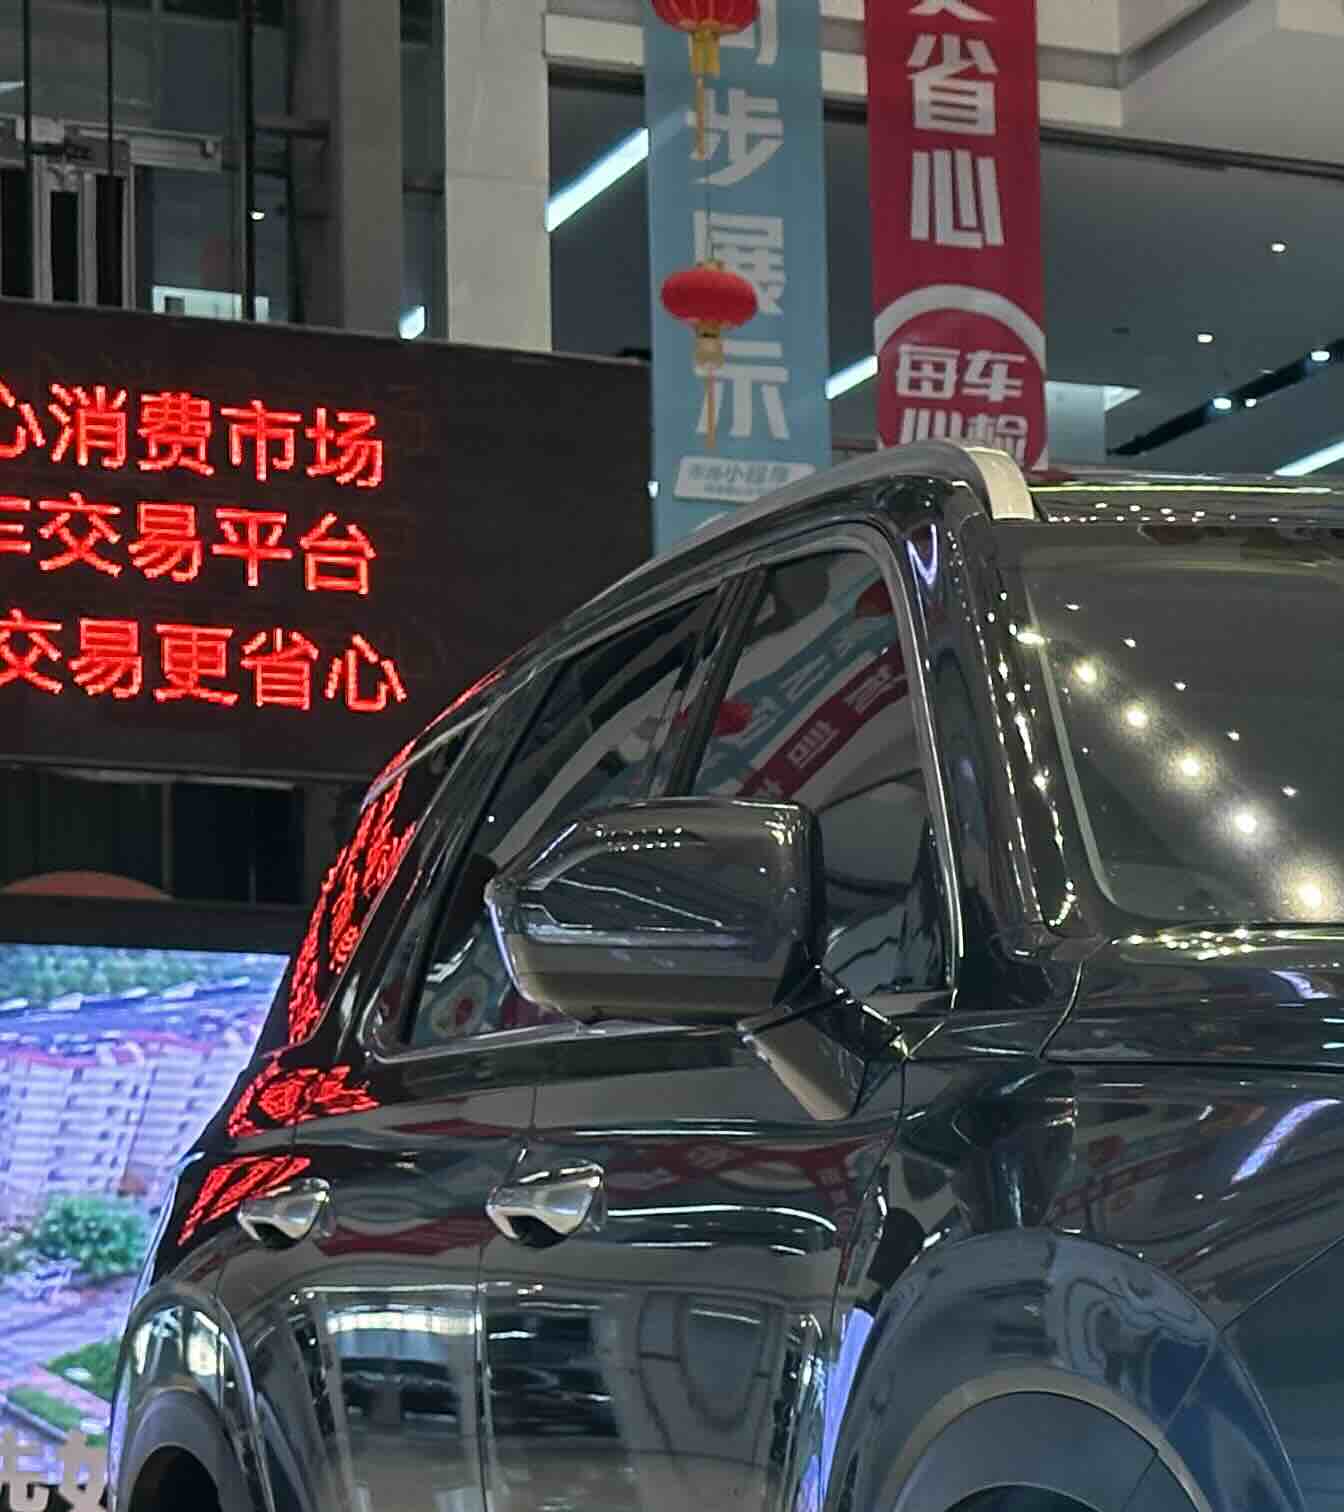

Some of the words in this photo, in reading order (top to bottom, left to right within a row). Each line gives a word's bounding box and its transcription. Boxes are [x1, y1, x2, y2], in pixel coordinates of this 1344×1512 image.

[907, 0, 1005, 250] 省心
[896, 343, 1027, 402] 每车
[0, 608, 407, 712] 交易更省心
